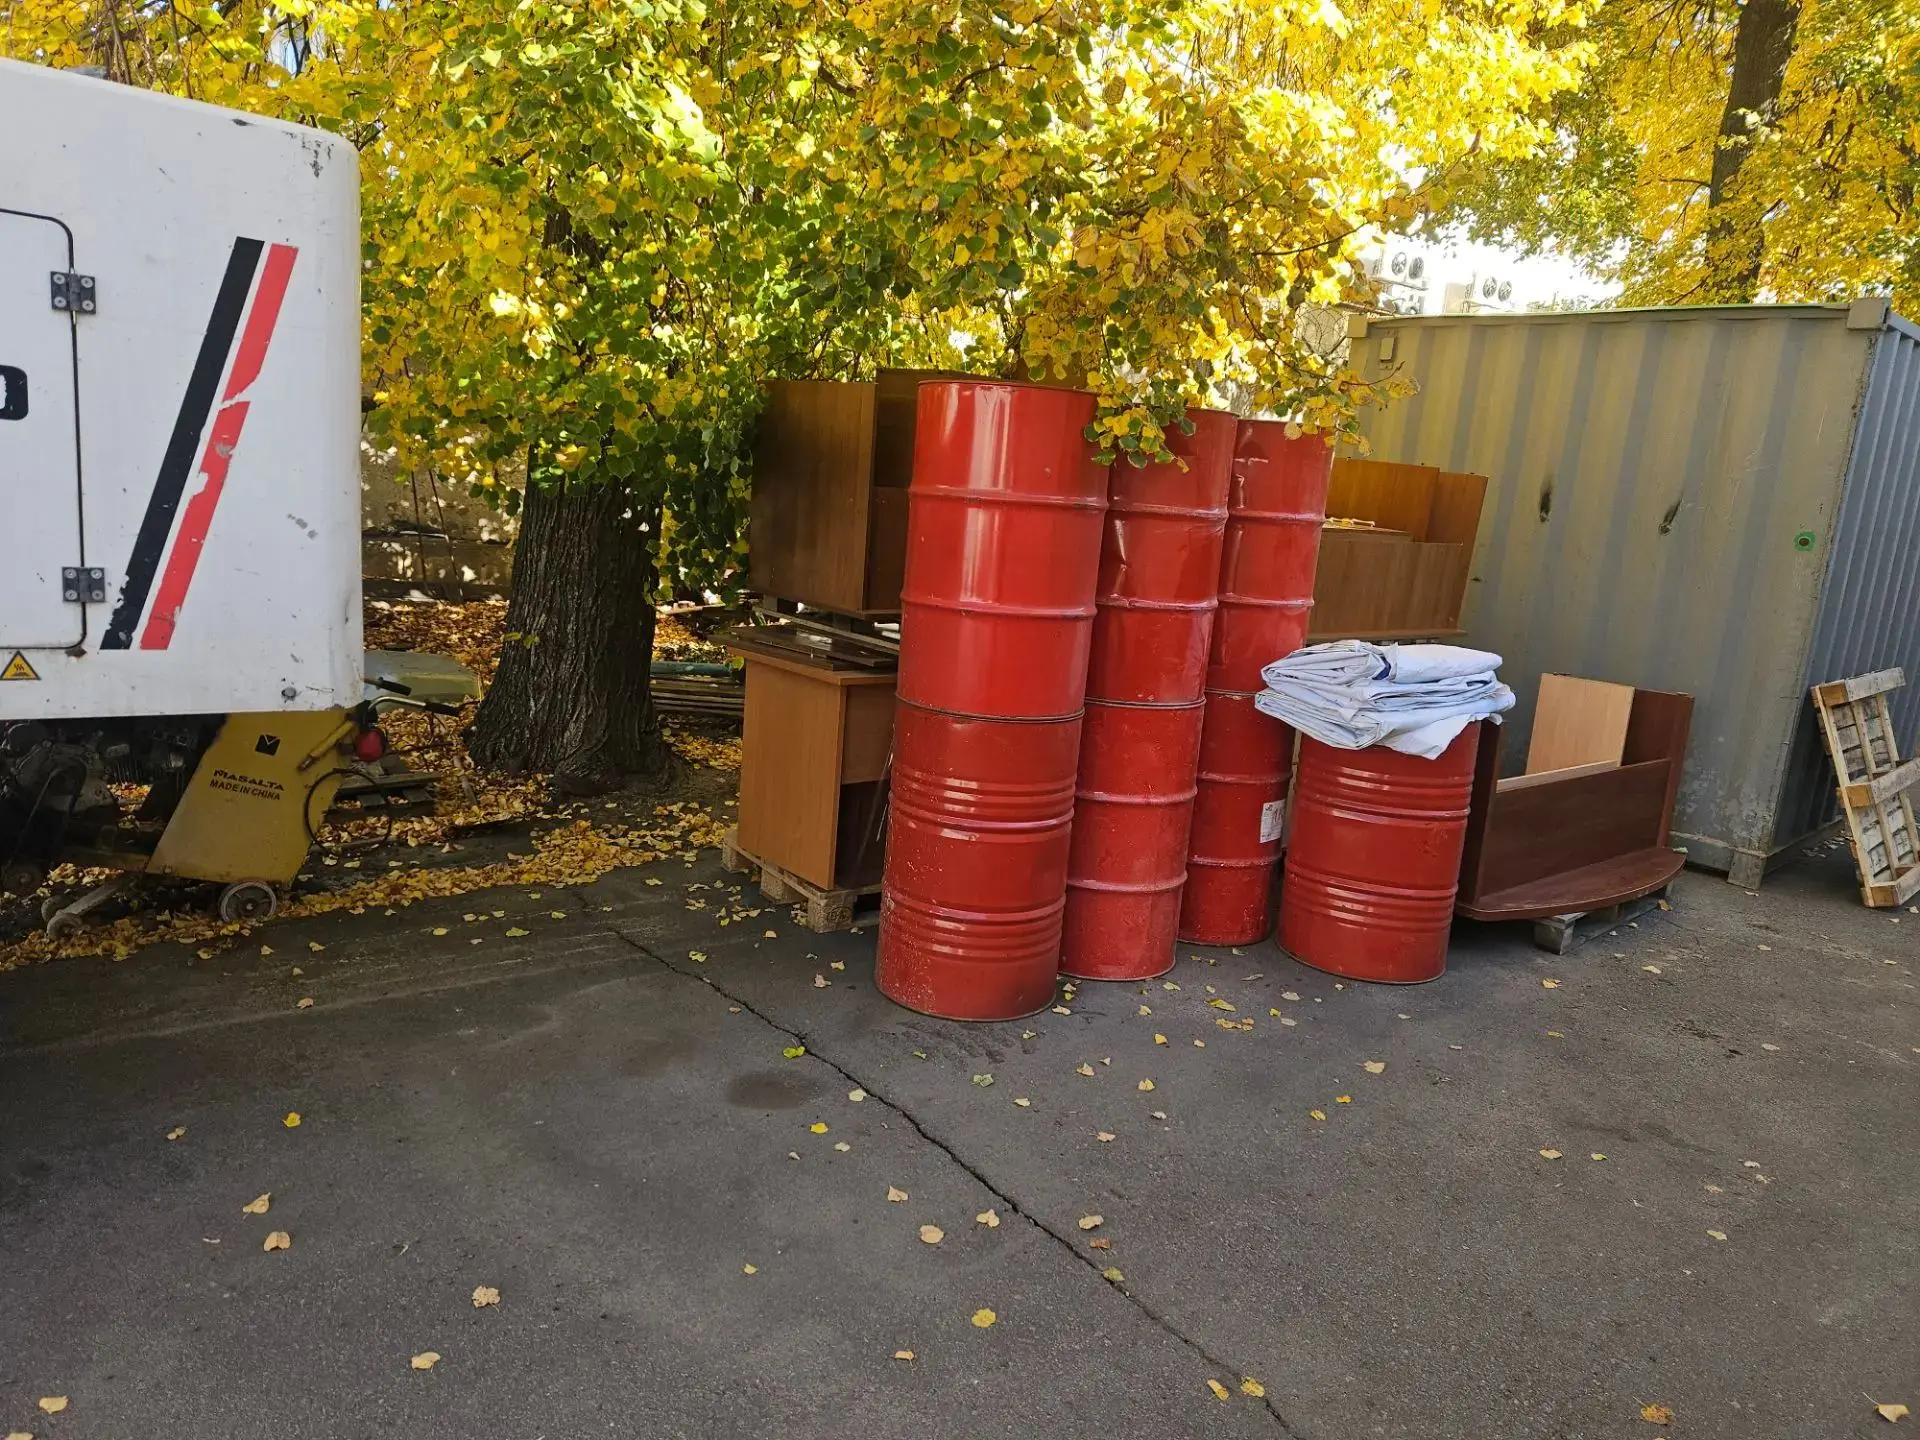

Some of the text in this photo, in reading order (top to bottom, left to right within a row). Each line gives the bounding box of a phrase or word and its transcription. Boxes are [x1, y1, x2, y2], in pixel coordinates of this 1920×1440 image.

[209, 780, 281, 800] MADE IN CHINA
[213, 769, 285, 791] MASALTA
